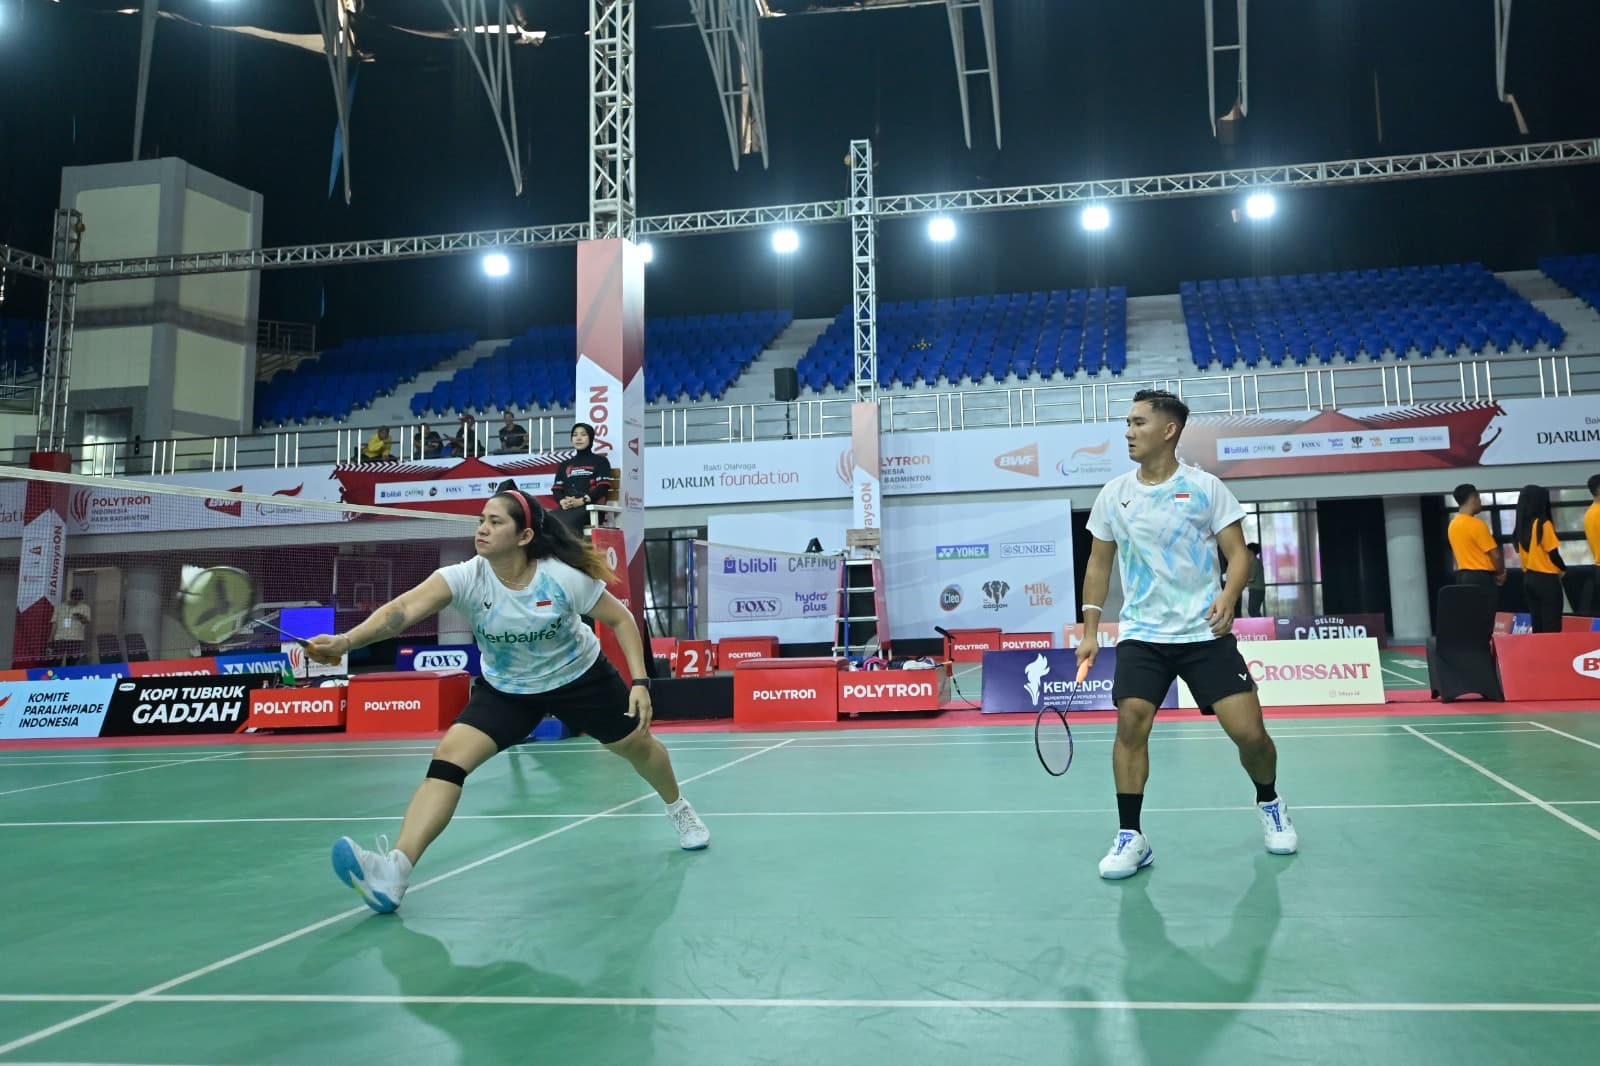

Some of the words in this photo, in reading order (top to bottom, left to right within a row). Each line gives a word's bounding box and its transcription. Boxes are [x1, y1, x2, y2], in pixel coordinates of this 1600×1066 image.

[589, 386, 613, 458] ysON
[1536, 429, 1600, 445] DJARUM
[724, 462, 757, 472] Olahraga
[880, 454, 932, 467] LYTRON
[1000, 456, 1035, 467] BWF
[880, 468, 905, 476] NESIA
[661, 476, 715, 490] DJARUM
[720, 470, 799, 487] foundation
[883, 475, 932, 485] BADMINTON
[92, 495, 151, 507] POLYTRON
[861, 482, 876, 531] aysON
[956, 546, 986, 558] YONEX
[1013, 543, 1054, 554] SUNRISE
[739, 557, 777, 573] blibli
[1024, 583, 1052, 595] Milk
[795, 591, 828, 605] hydro
[943, 593, 961, 604] Cleo
[1029, 594, 1053, 607] Life
[803, 602, 828, 614] plus
[1314, 617, 1345, 625] DELIZIO
[478, 622, 556, 643] Herbalife
[1294, 625, 1368, 641] CAFFINO
[954, 643, 990, 651] POLYTRON
[1003, 640, 1051, 650] POLYTRON
[683, 649, 699, 673] 2
[705, 648, 713, 672] 2
[728, 651, 763, 659] POLYTRON
[246, 660, 290, 677] YONEX
[1247, 660, 1371, 682] CROISSANT
[1583, 657, 1600, 672] B
[139, 687, 179, 701] KOPI
[182, 685, 246, 700] TUBRUK
[843, 683, 933, 698] POLYTRON
[1043, 679, 1114, 694] KEMENPO
[28, 691, 70, 703] KOMITE
[752, 688, 817, 700] POLYTRON
[23, 703, 104, 716] PARALIMPIADE
[253, 699, 334, 715] POLYTRON
[364, 700, 421, 711] POLYTRON
[132, 701, 241, 724] GADJAH
[18, 716, 79, 728] INDONESIA
